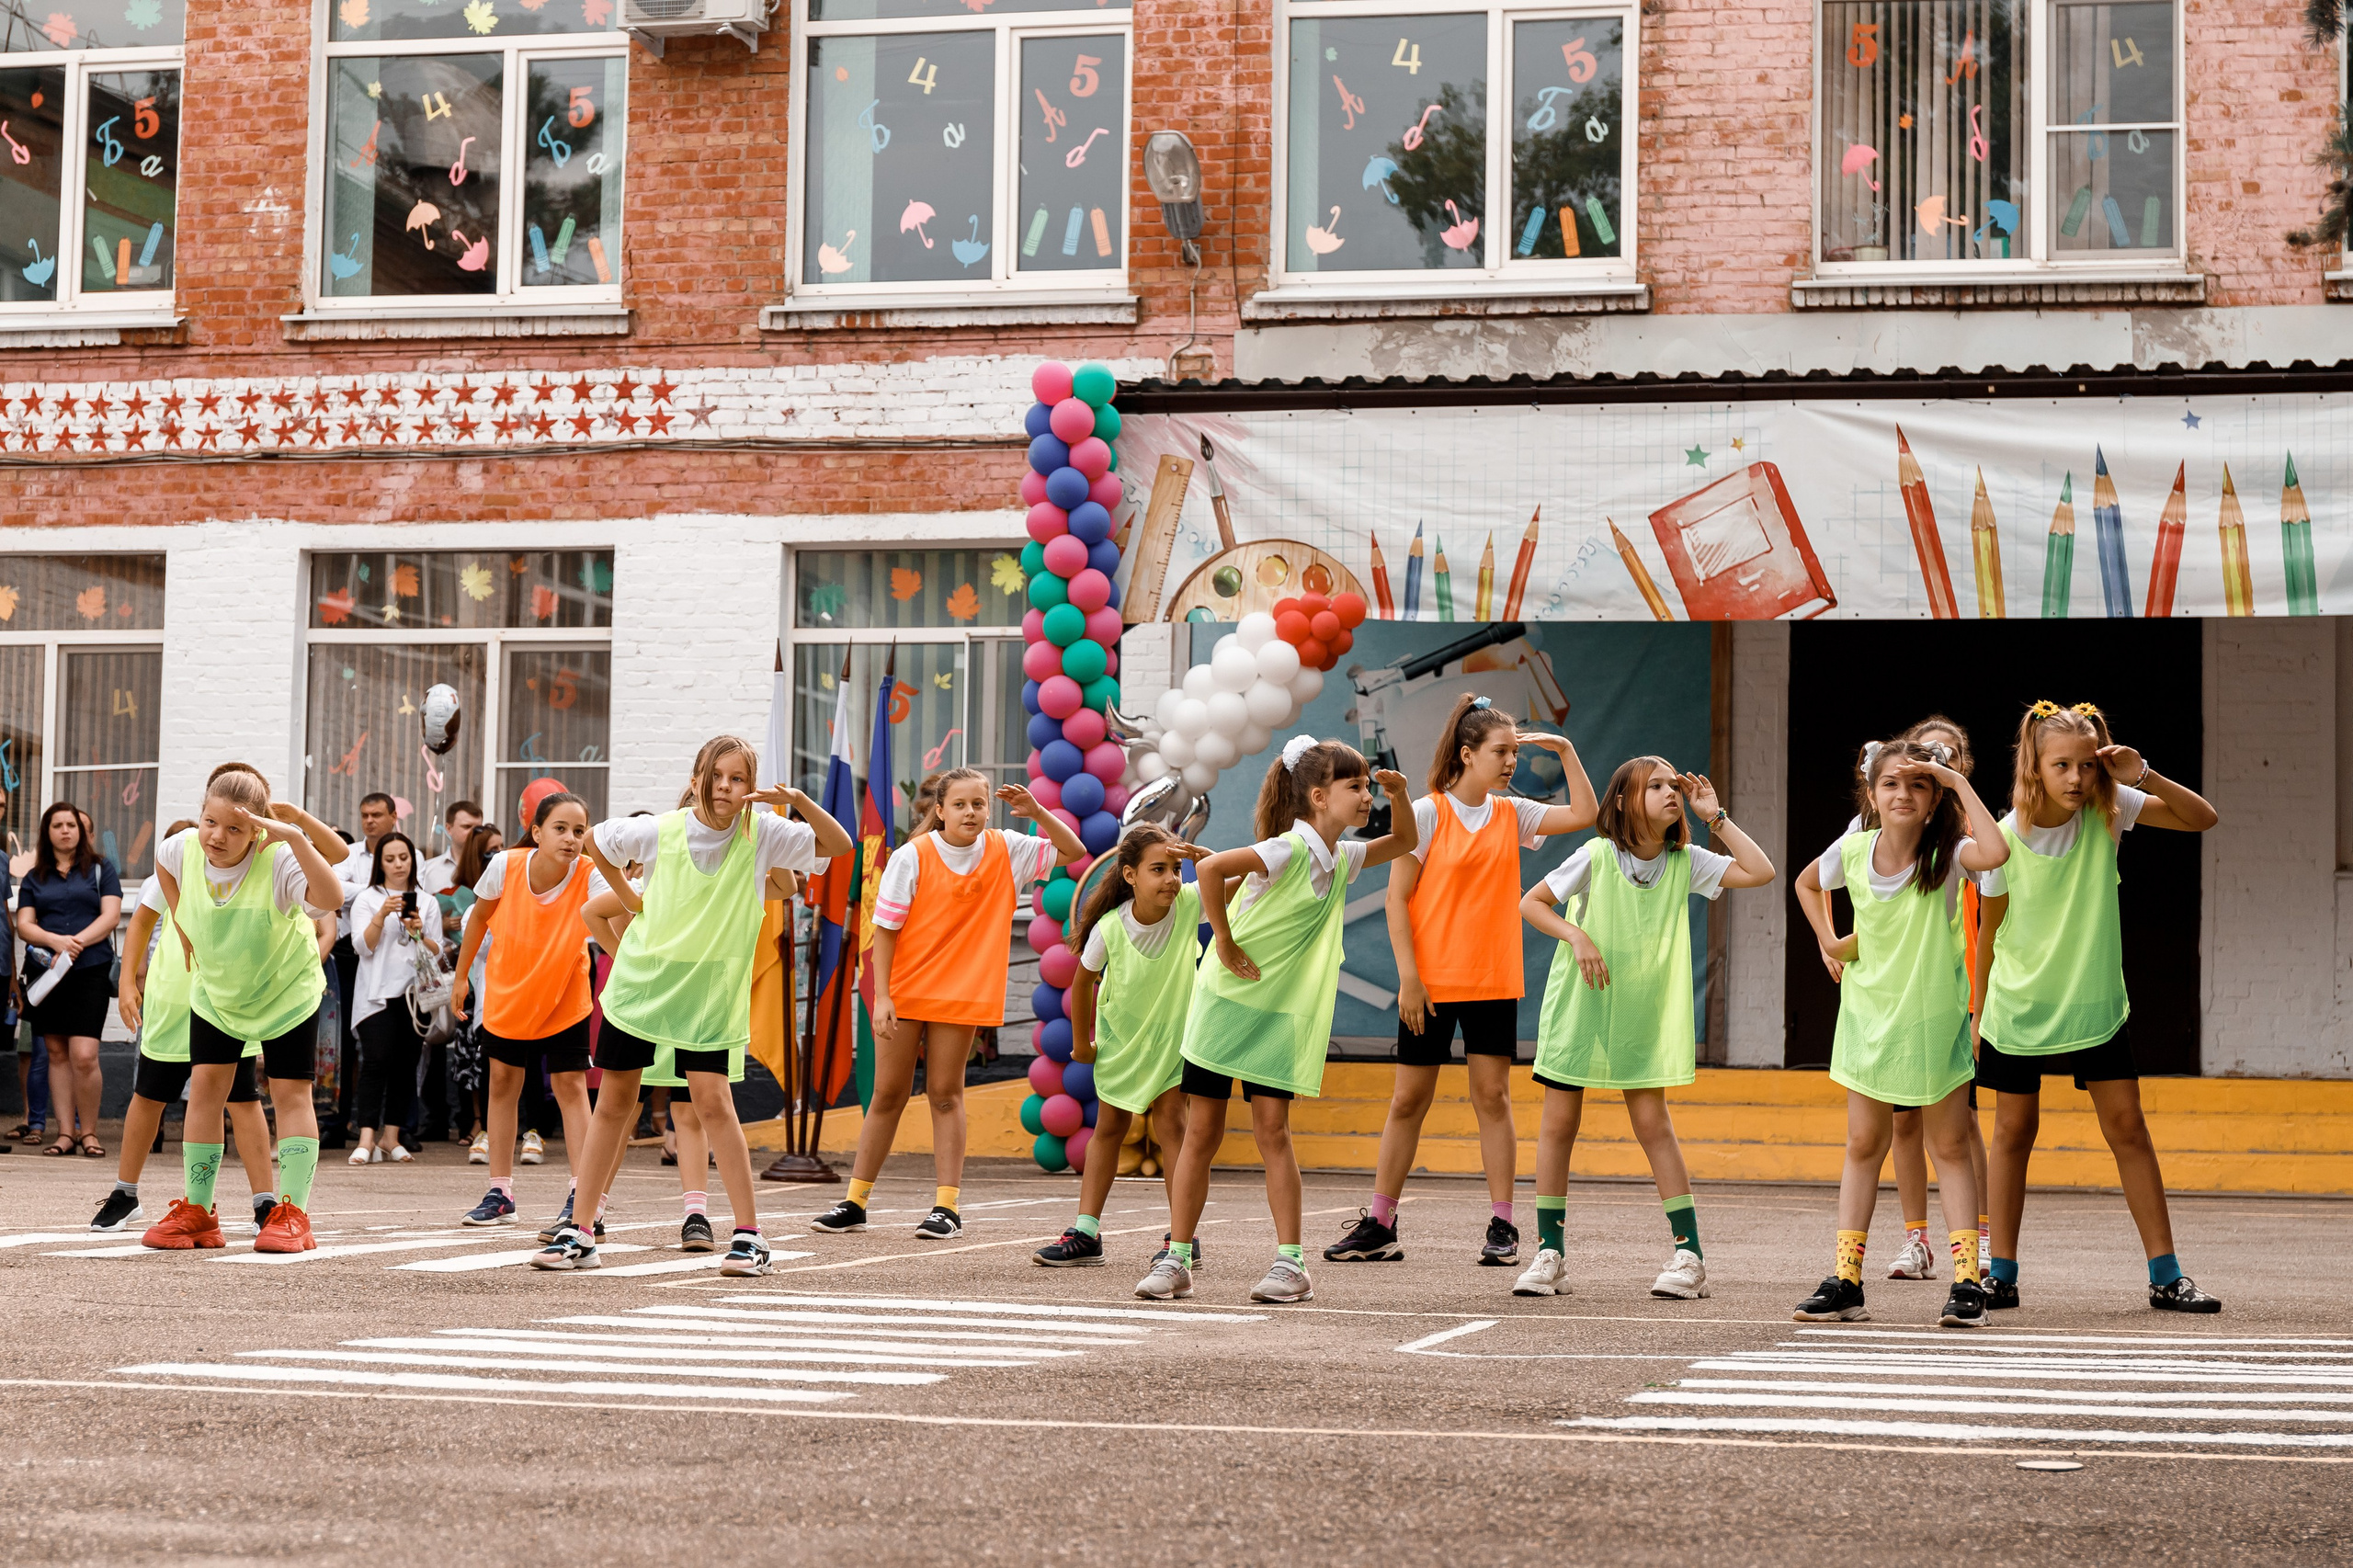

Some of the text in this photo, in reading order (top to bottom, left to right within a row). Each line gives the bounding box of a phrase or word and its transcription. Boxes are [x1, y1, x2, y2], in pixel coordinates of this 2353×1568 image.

[1391, 38, 1422, 75] 4
[1561, 37, 1597, 84] 5
[1847, 23, 1880, 68] 5
[2110, 37, 2144, 69] 4
[907, 56, 938, 95] 4
[1069, 53, 1102, 97] 5
[134, 96, 160, 139] 5
[421, 91, 452, 121] 4
[567, 85, 595, 128] 5
[113, 688, 138, 720] 4
[550, 667, 581, 710] 5
[888, 679, 919, 724] 5
